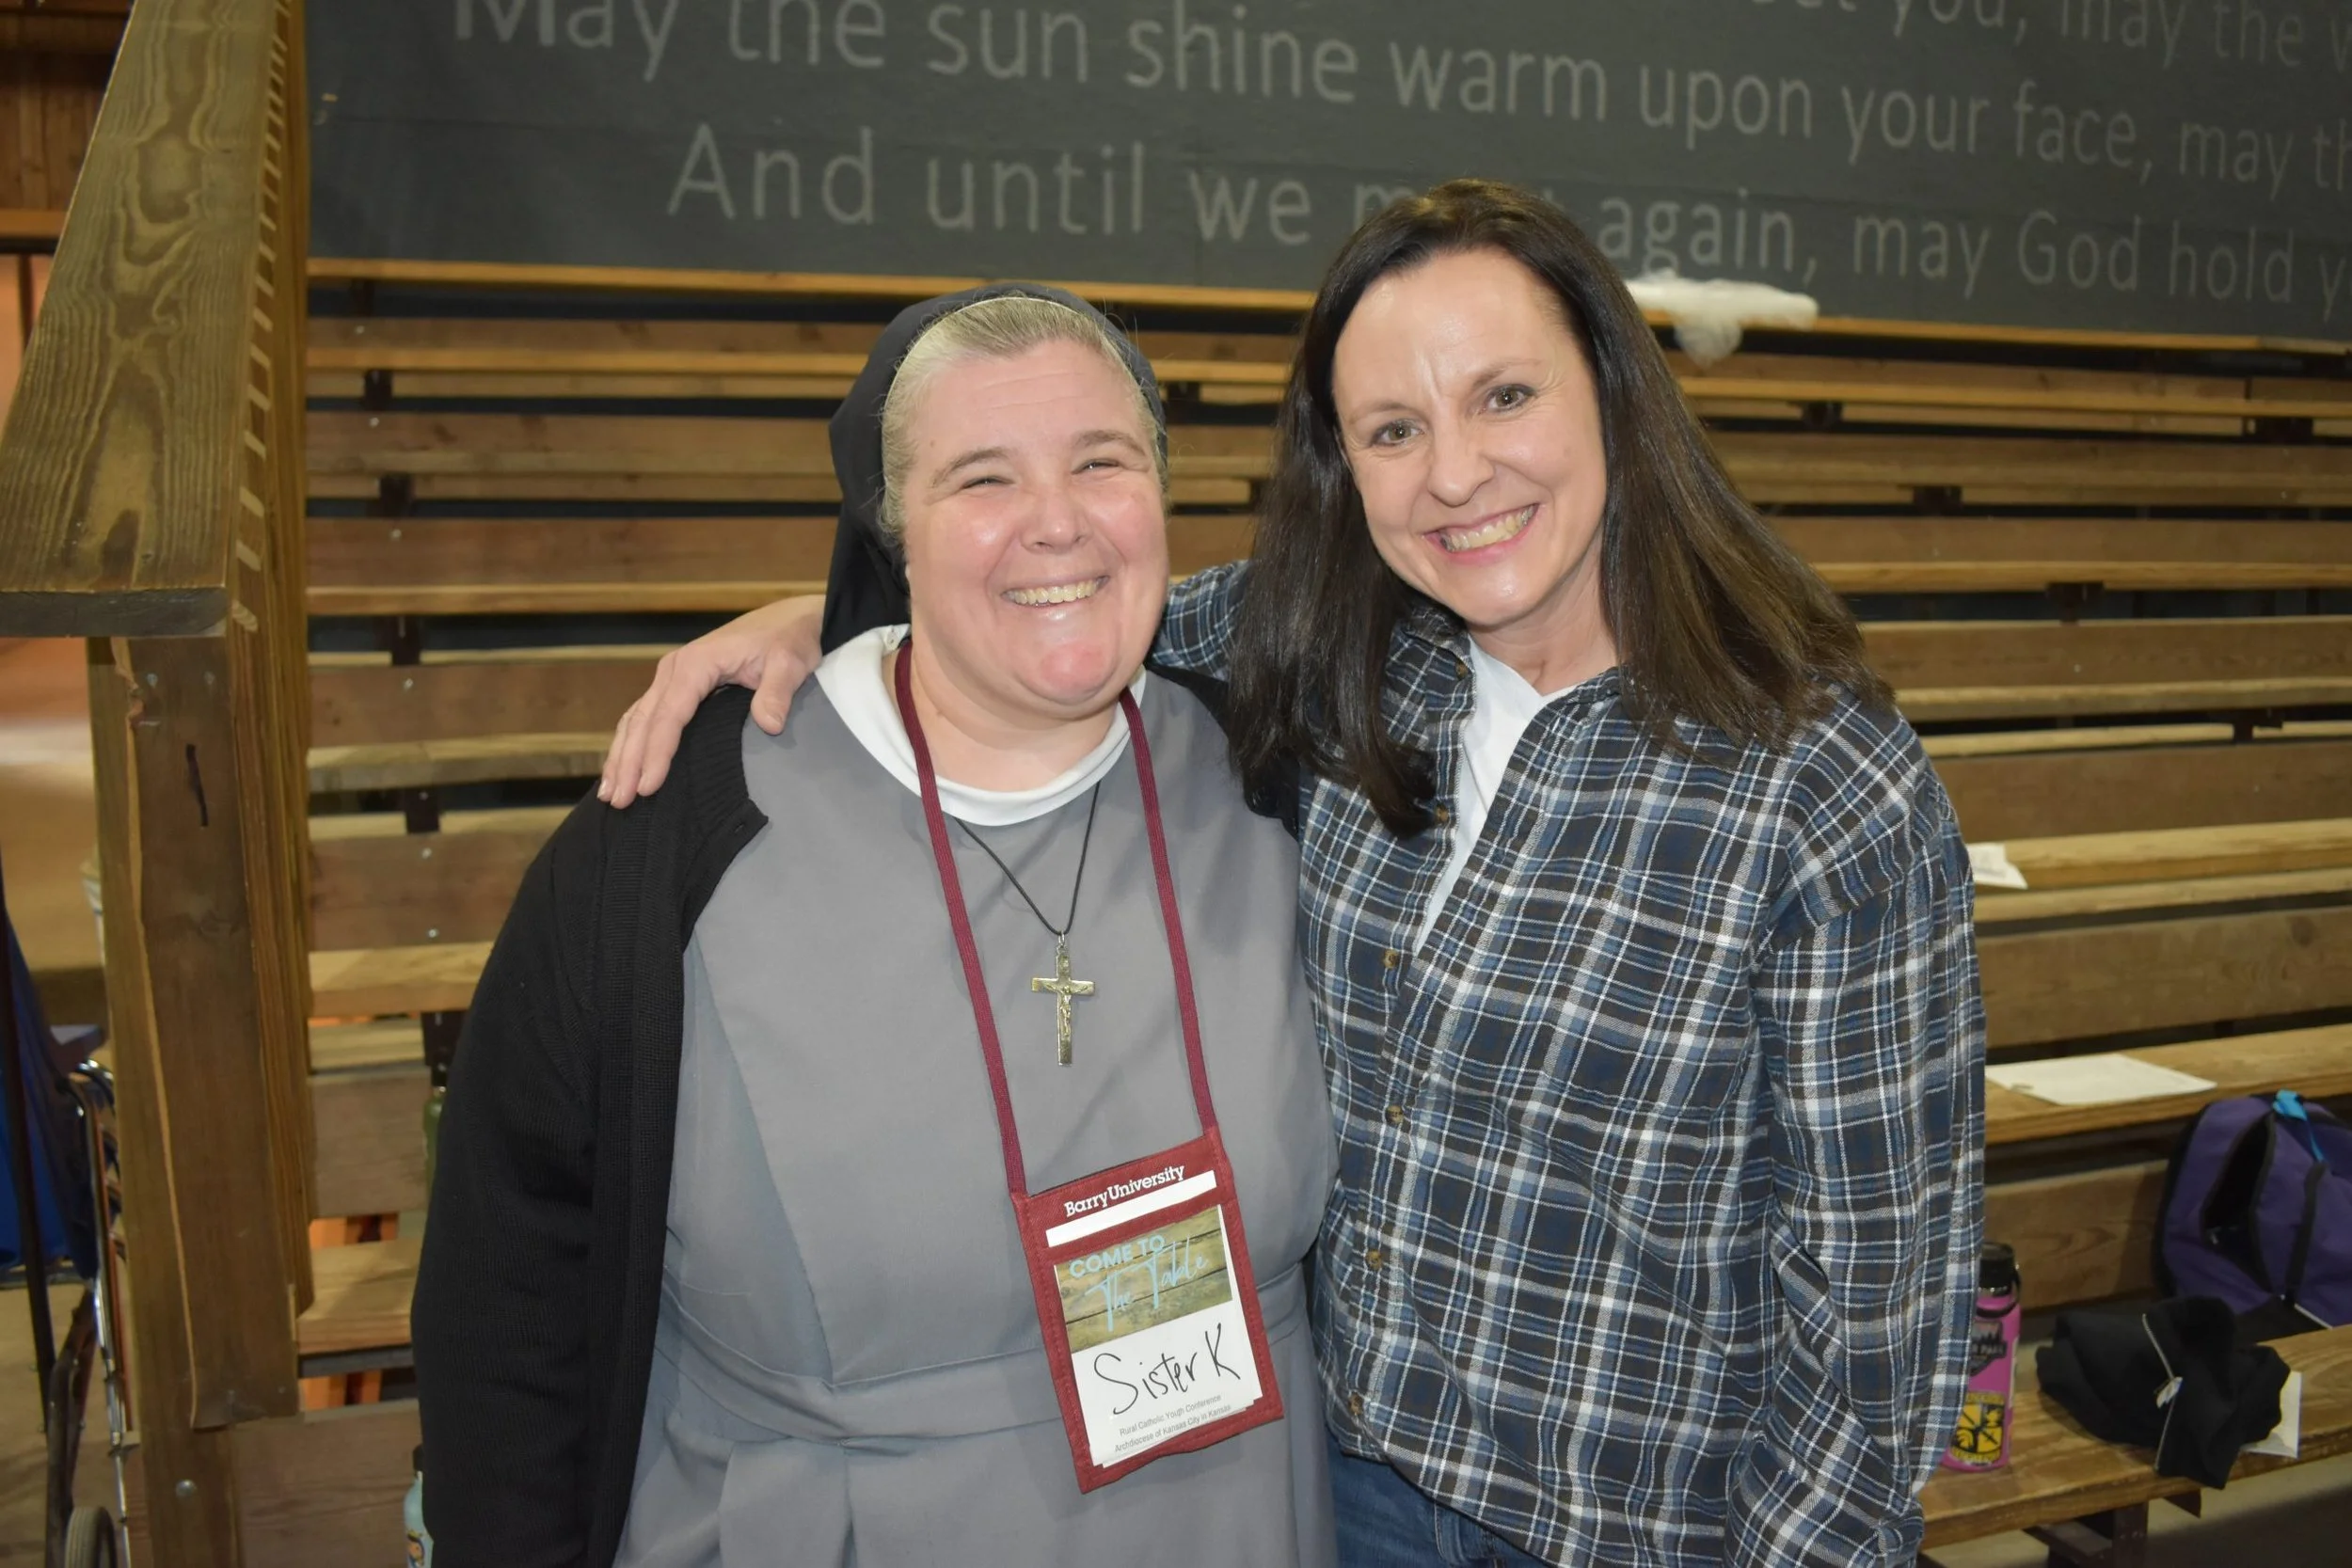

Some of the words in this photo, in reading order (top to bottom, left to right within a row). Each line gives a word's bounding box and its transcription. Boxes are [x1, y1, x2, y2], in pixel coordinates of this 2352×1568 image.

[2060, 0, 2186, 70] may
[2213, 3, 2306, 68] the
[728, 0, 886, 68] the
[927, 4, 1089, 84] sun
[1124, 0, 1357, 103] shine
[1390, 41, 1605, 120] warm
[1638, 64, 1812, 150] upon
[1841, 85, 1990, 166] your
[2013, 79, 2153, 185] face,
[2178, 119, 2294, 201] may
[667, 122, 873, 225] And
[926, 141, 1144, 235] until
[1188, 167, 1311, 245] we
[1599, 187, 1819, 286] again,
[1852, 213, 1991, 300] may
[2017, 209, 2142, 292] God
[2168, 218, 2294, 304] hold
[1064, 1191, 1108, 1217] Barry
[1107, 1165, 1184, 1200] University
[1069, 1243, 1134, 1278] COME
[1136, 1234, 1166, 1255] TO
[1132, 1236, 1209, 1310] Table
[1093, 1351, 1198, 1415] Sister
[1204, 1323, 1241, 1380] K
[1115, 1433, 1154, 1452] Archdiocese
[1162, 1421, 1187, 1434] Kansas
[1187, 1415, 1200, 1427] City
[1208, 1404, 1232, 1418] Kansas
[1120, 1425, 1137, 1436] Rural
[1137, 1415, 1165, 1430] Catholic
[1185, 1394, 1221, 1413] Conference
